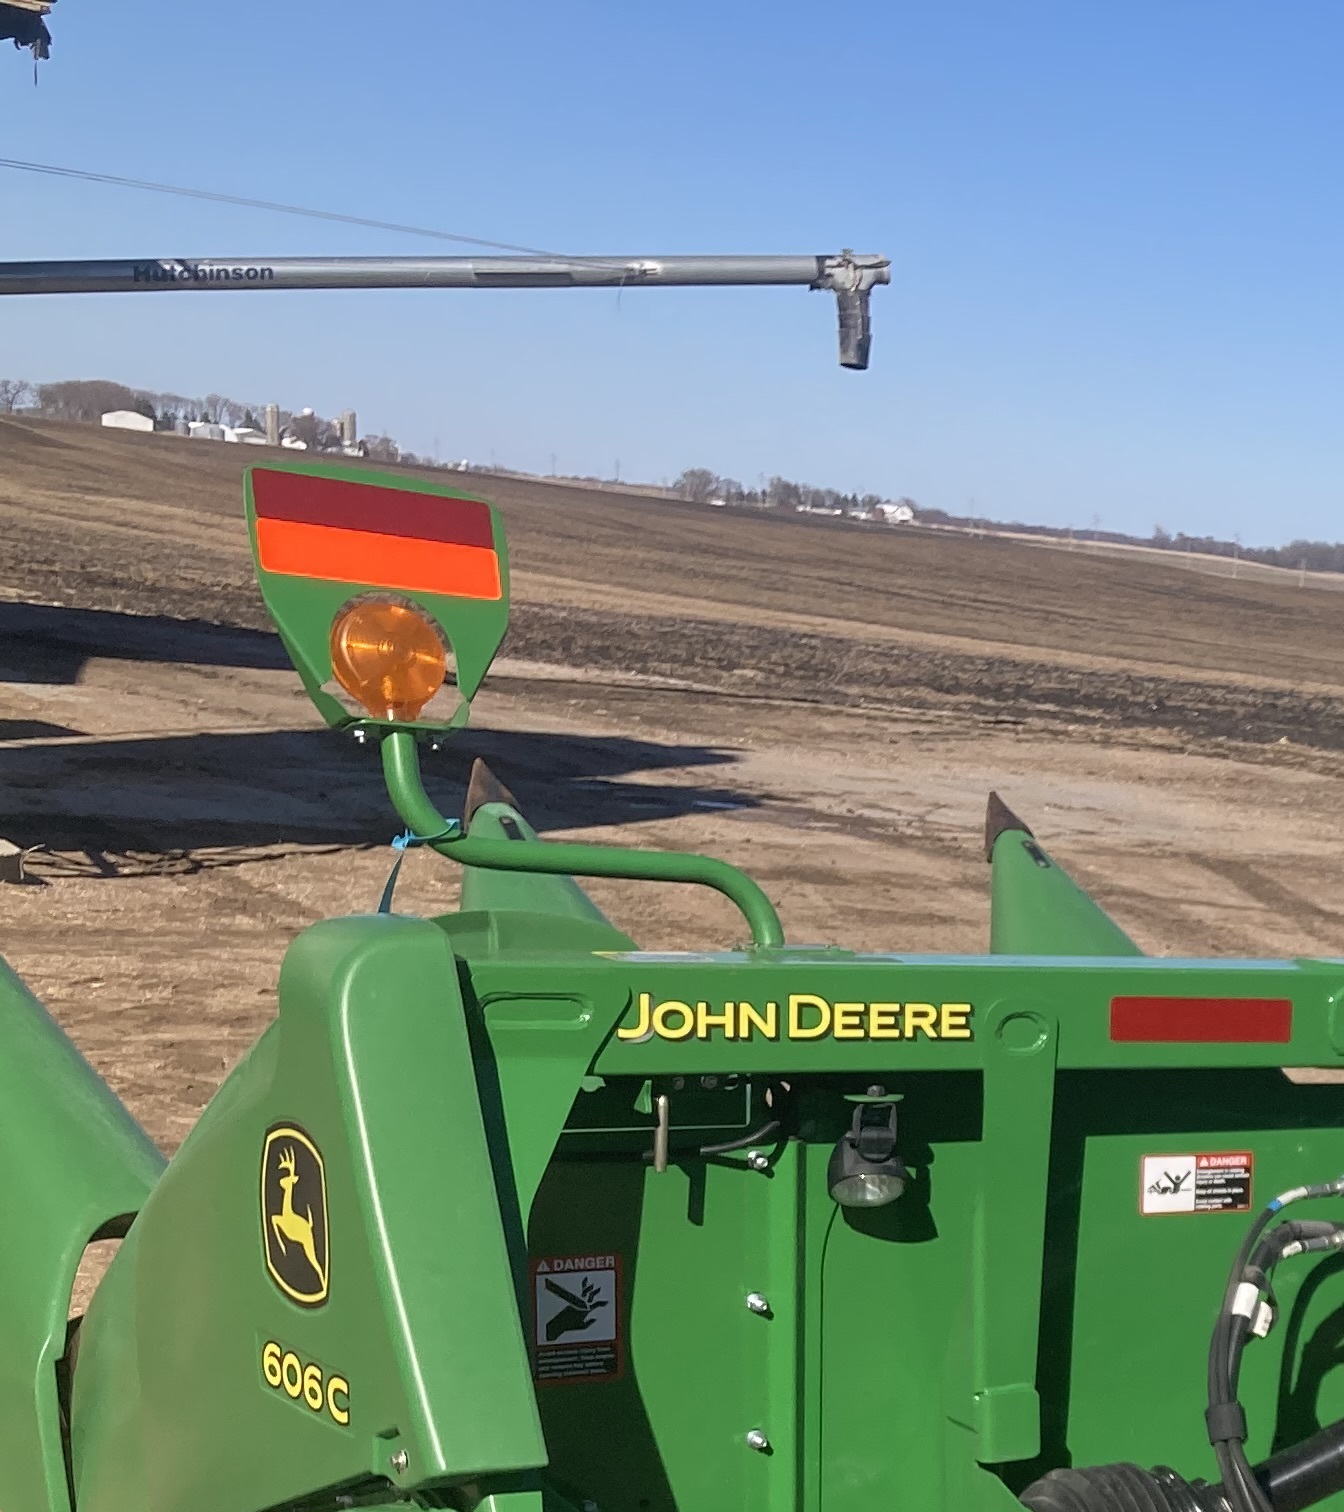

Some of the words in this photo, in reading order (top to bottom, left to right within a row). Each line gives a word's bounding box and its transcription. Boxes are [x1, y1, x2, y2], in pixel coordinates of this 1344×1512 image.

[133, 264, 274, 282] Hutchinson
[616, 992, 778, 1041] JOHN
[787, 993, 973, 1041] DEERE
[1210, 1156, 1247, 1167] DANGER
[553, 1255, 615, 1271] DANGER
